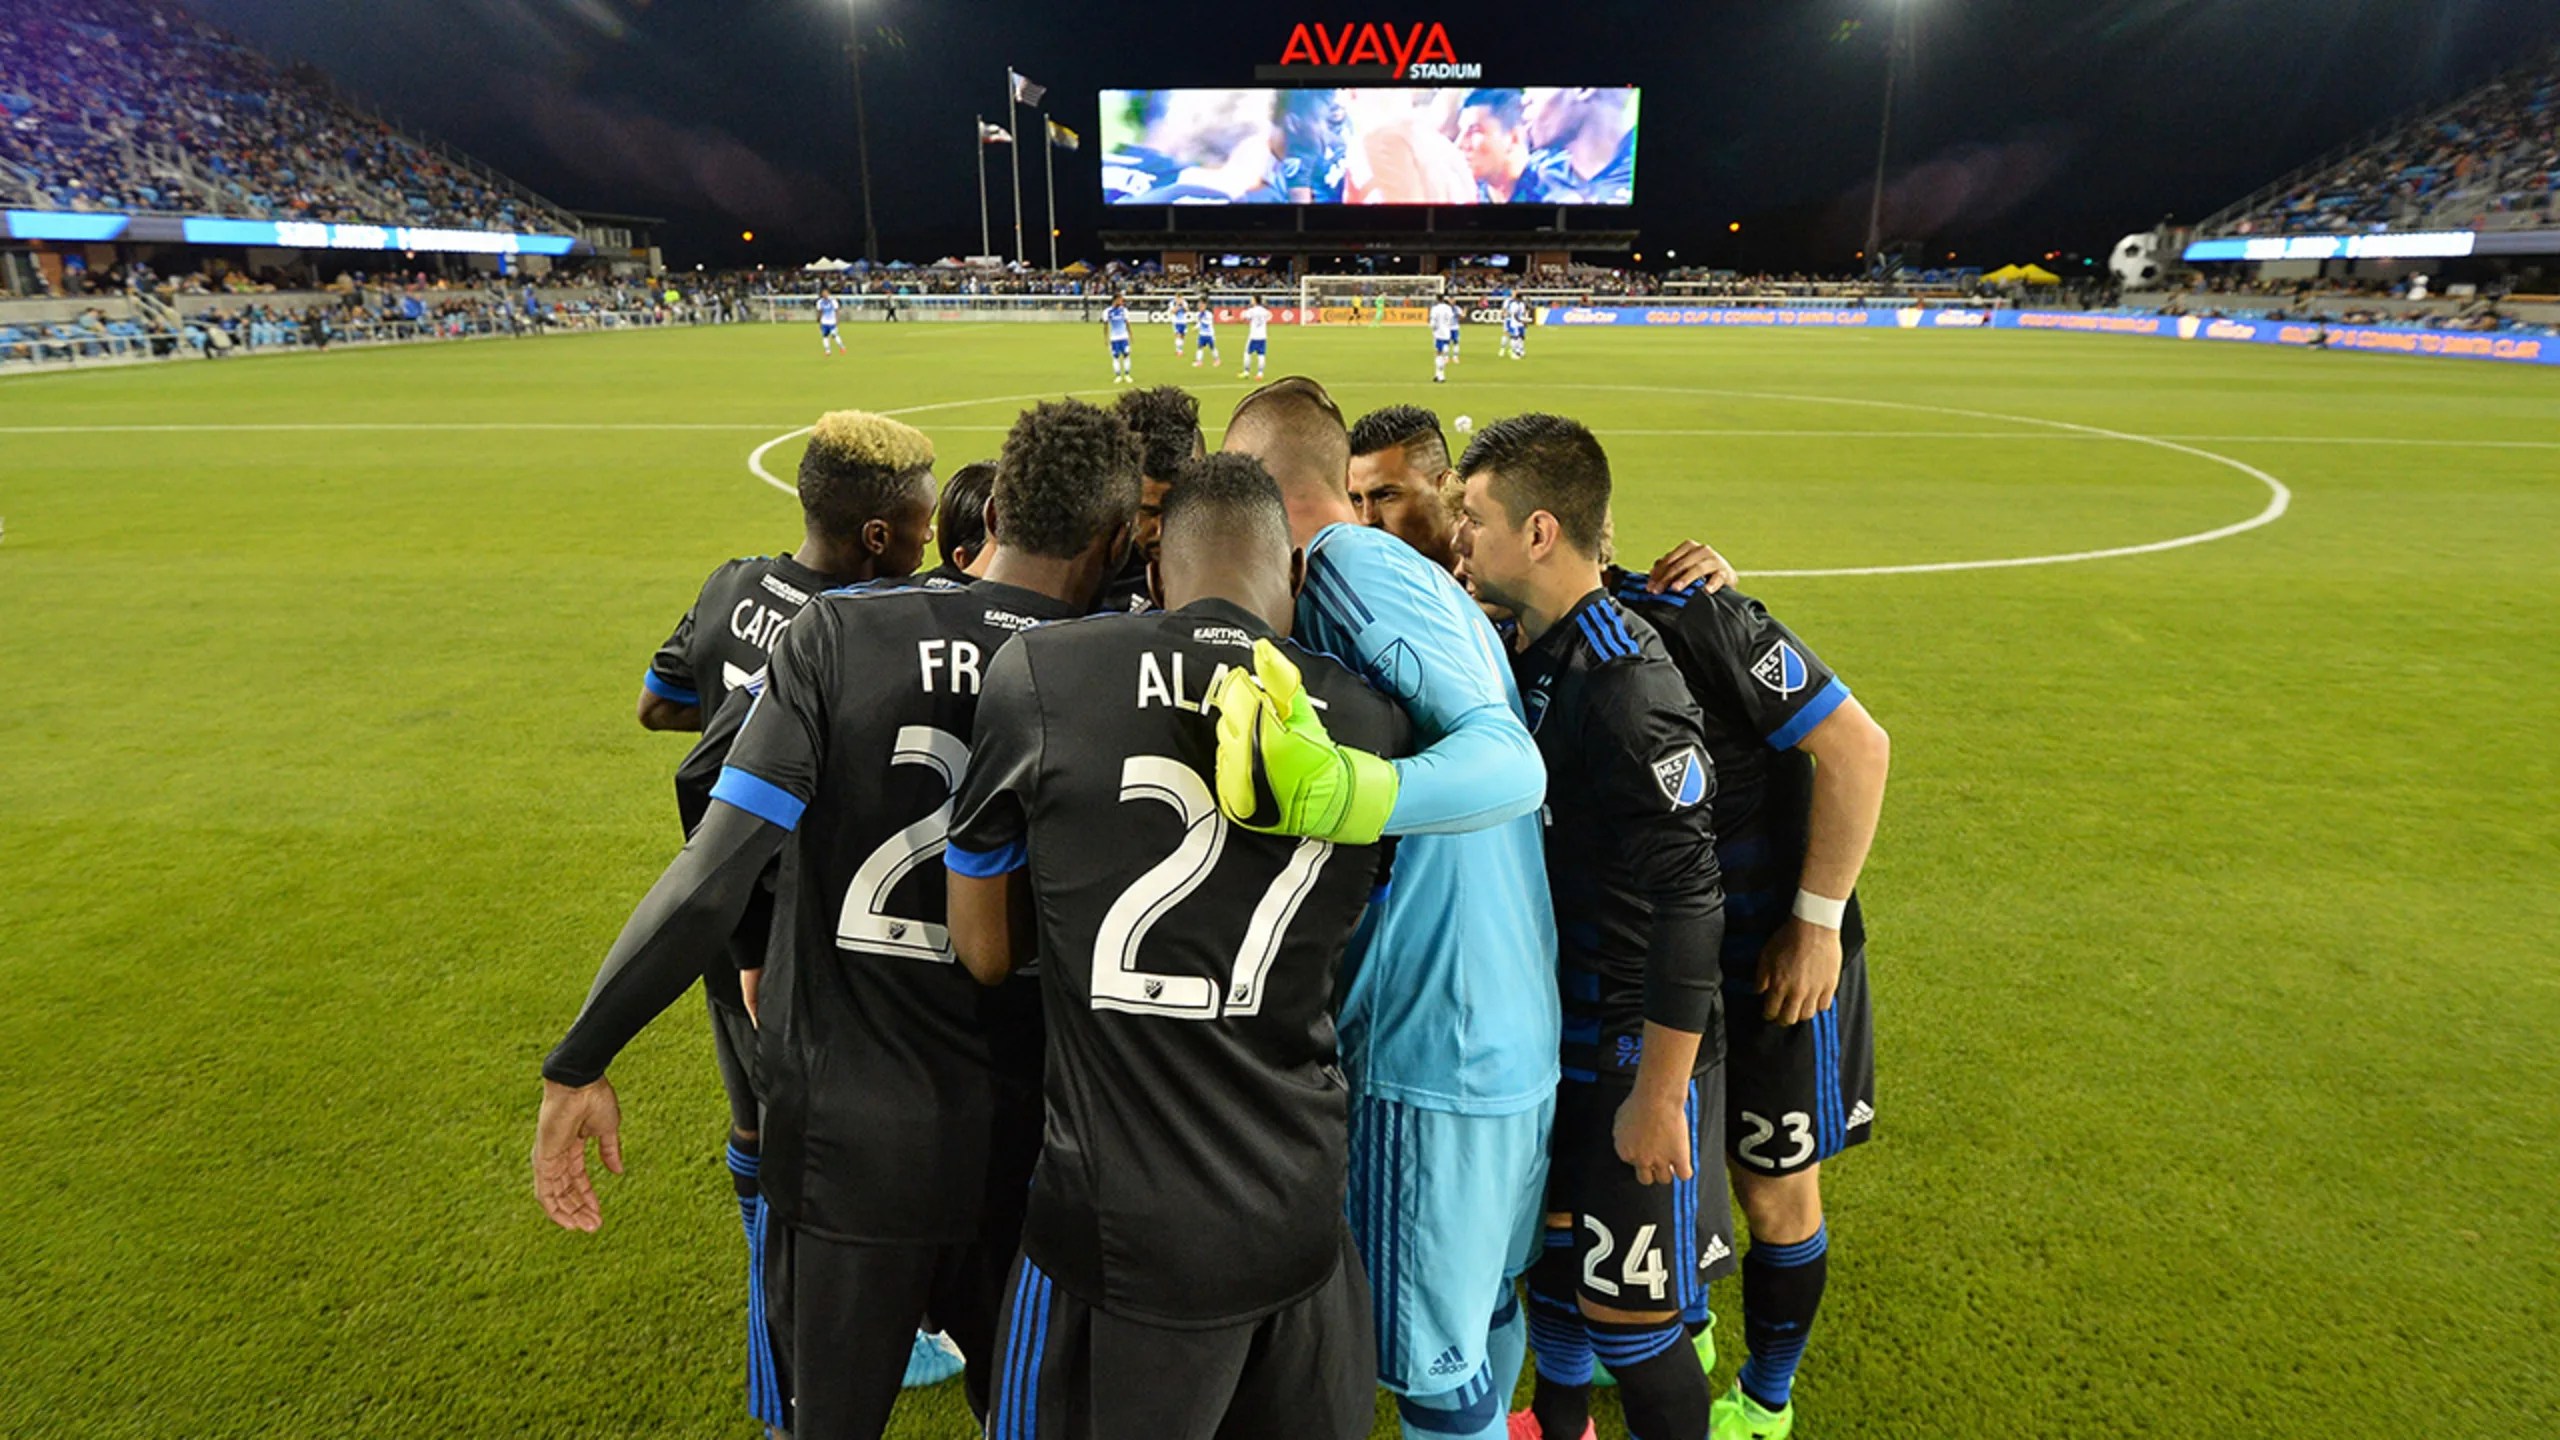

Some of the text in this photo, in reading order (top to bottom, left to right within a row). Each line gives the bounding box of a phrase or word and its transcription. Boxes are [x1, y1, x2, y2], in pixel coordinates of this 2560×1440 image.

[1280, 22, 1457, 79] AVAYA
[1409, 63, 1482, 79] STADIUM
[1168, 264, 1190, 274] TCL
[1541, 263, 1563, 274] TCL
[1757, 653, 1779, 677] MLS
[1659, 759, 1682, 778] MLS
[1092, 755, 1334, 1019] 27
[1738, 1111, 1815, 1169] 23
[1583, 1213, 1669, 1300] 24
